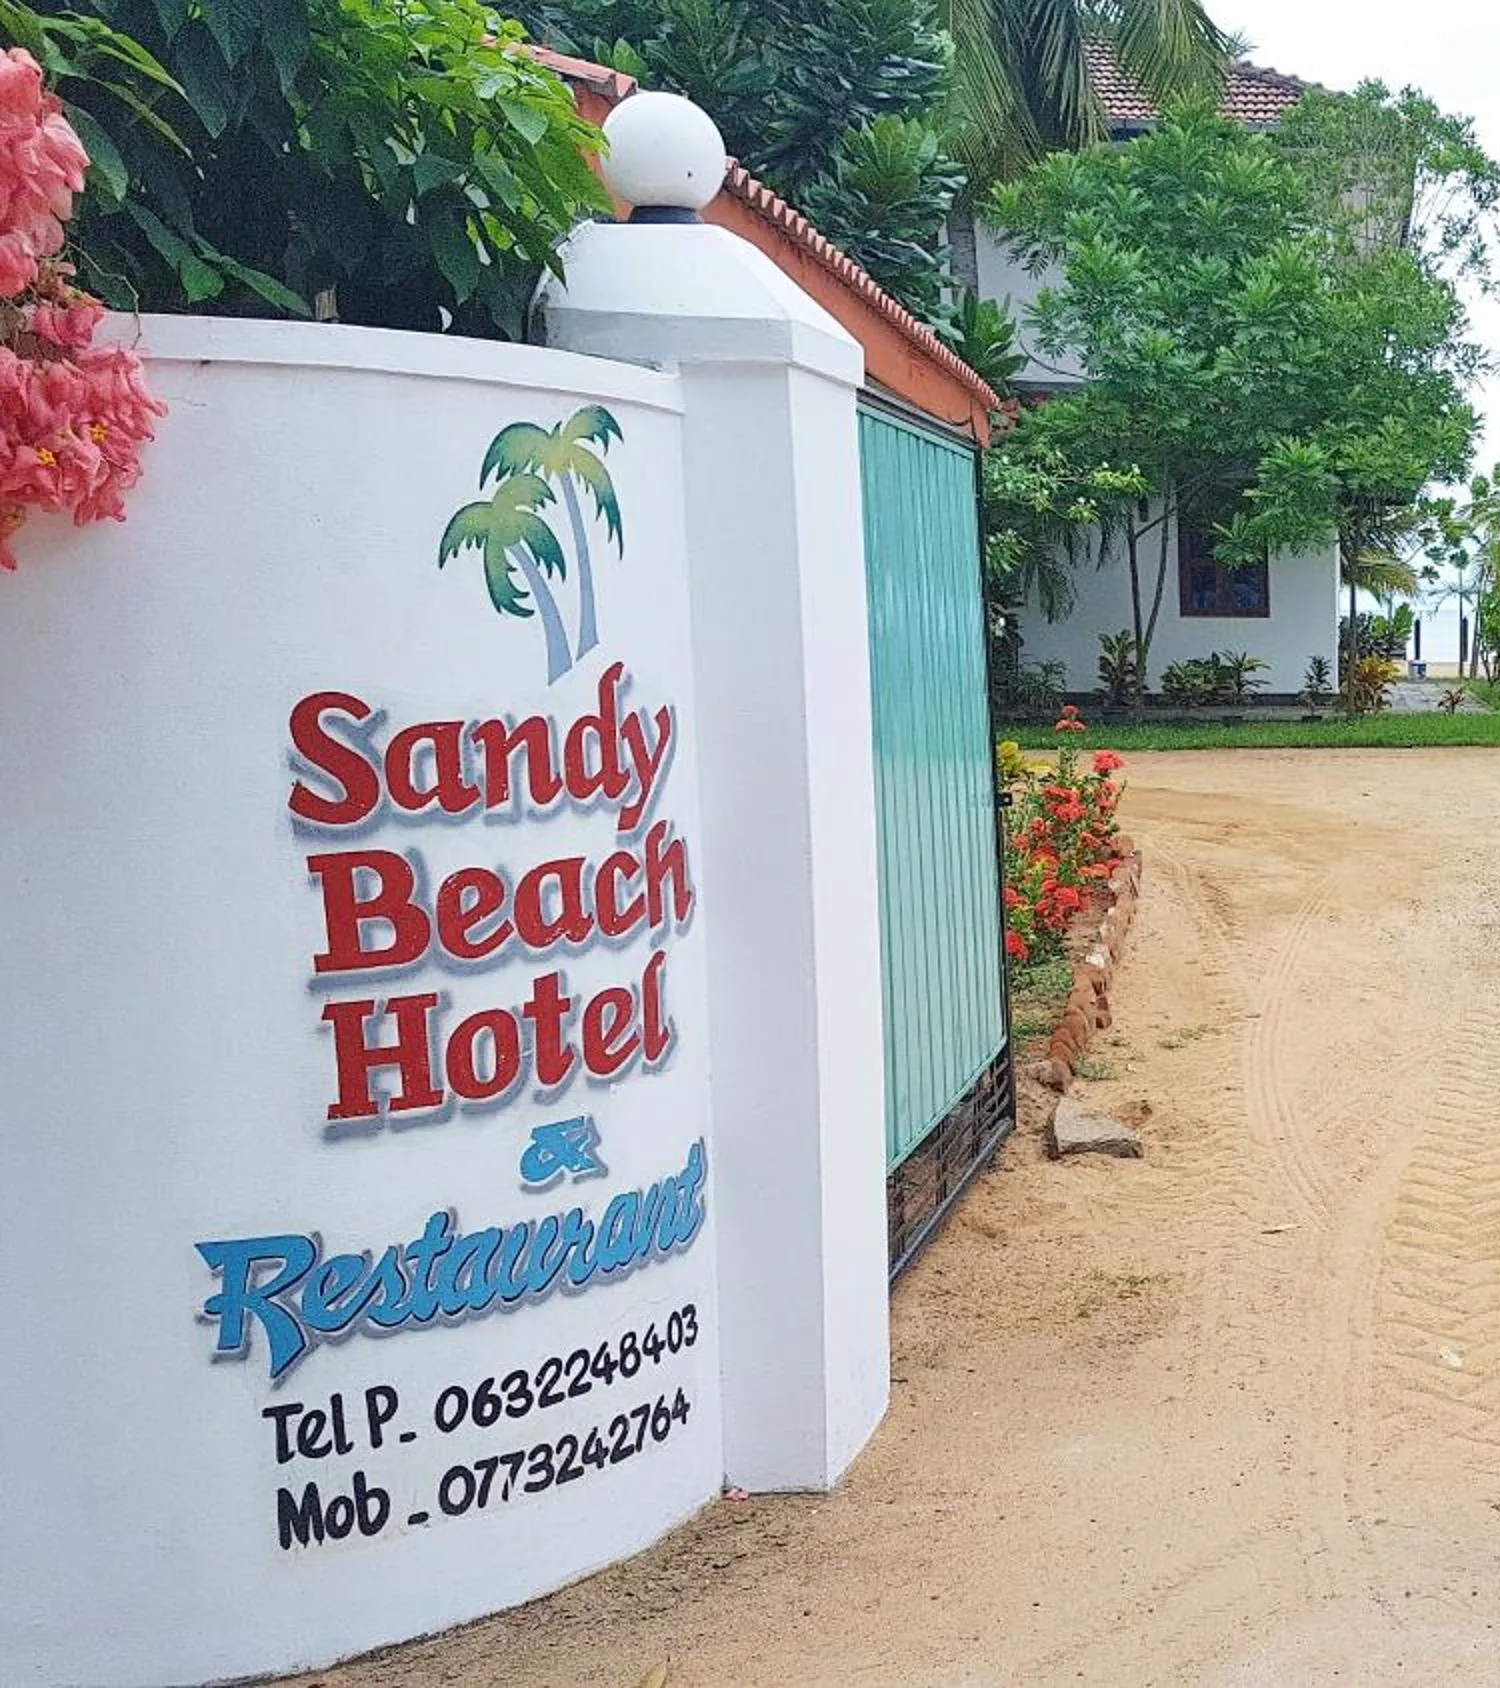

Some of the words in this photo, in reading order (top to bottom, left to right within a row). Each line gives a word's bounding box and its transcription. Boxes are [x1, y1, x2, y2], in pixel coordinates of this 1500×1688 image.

[288, 661, 672, 831] Sandy
[306, 819, 693, 974] Beach
[321, 950, 672, 1121] Hotel
[518, 1114, 603, 1184] &
[194, 1136, 706, 1379] Restaurant
[262, 1393, 354, 1465] Tel
[434, 1303, 699, 1434] 0632248403
[277, 1471, 391, 1550] Mob
[437, 1386, 692, 1516] 0773242764
